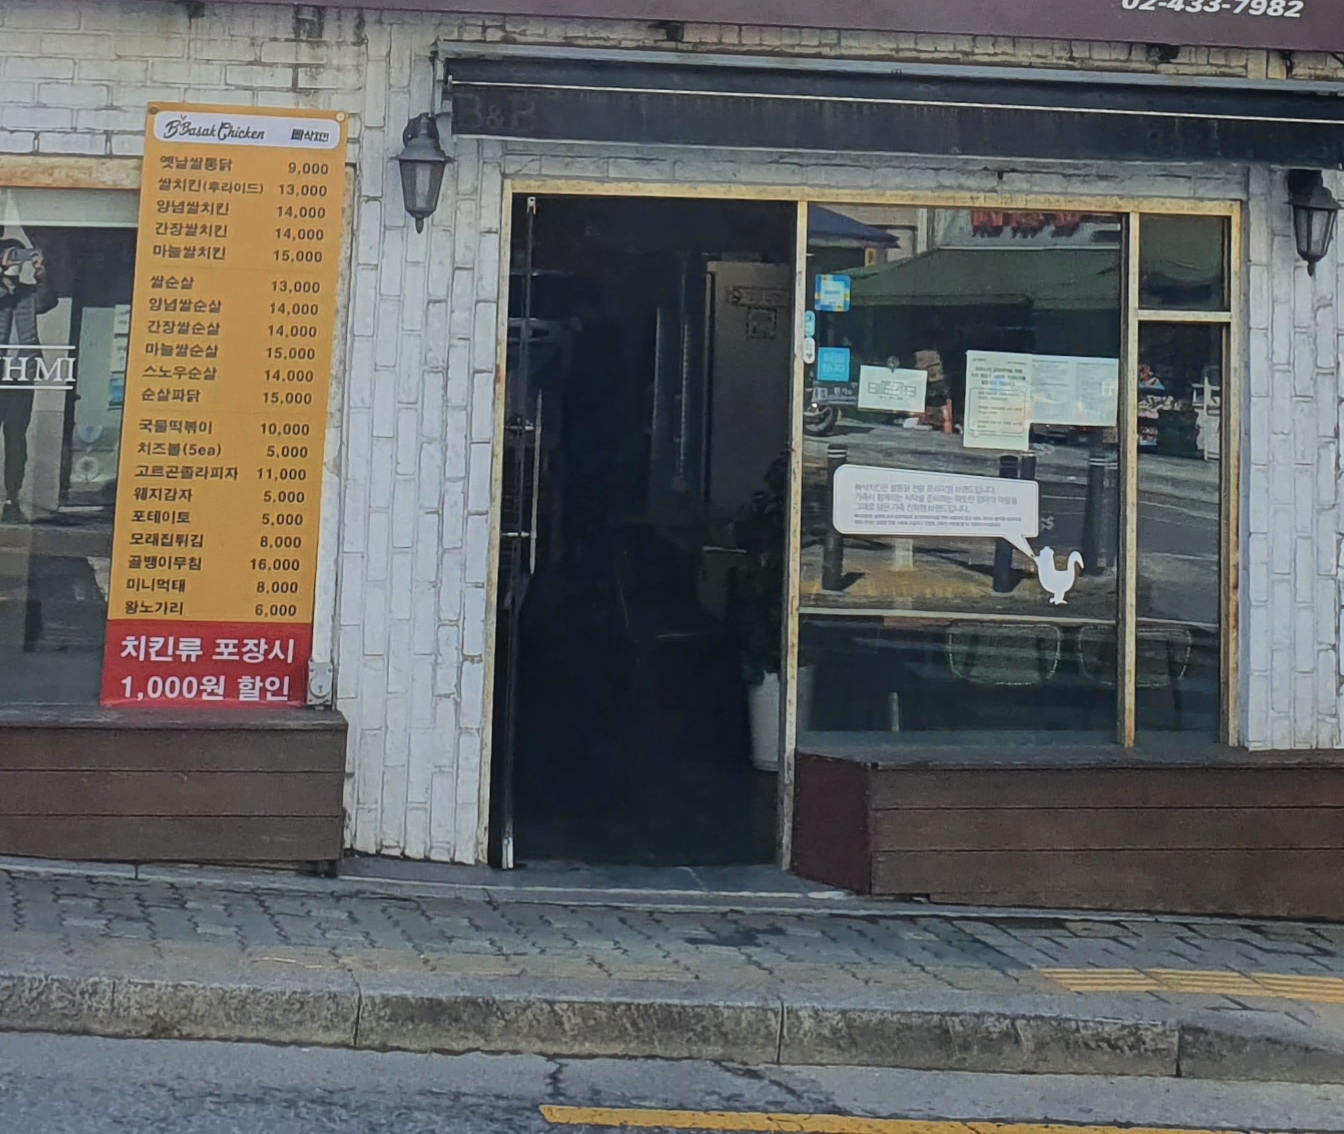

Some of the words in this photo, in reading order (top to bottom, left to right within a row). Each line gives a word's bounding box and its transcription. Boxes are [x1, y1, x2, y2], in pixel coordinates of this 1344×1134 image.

[218, 121, 266, 141] Chicken
[160, 155, 233, 172] 옛날쌀통닭
[288, 162, 329, 175] 9,000
[158, 177, 264, 195] 쌀치킨(후라이드)
[279, 183, 327, 197] 13,000
[156, 199, 230, 216] 양념쌀치킨
[277, 205, 326, 219] 14,000
[155, 222, 228, 238] 간장쌀치킨
[275, 227, 324, 241] 14,000
[153, 244, 226, 260] 마늘쌀치킨
[273, 250, 323, 263] 15,000
[150, 274, 195, 291] 쌀순살
[271, 280, 320, 294] 13,000
[149, 297, 222, 314] 양념쌀순살
[269, 302, 319, 316] 14,000
[147, 320, 221, 336] 간장쌀순살
[267, 324, 317, 338] 14,000
[145, 342, 219, 359] 마늘쌀순살
[266, 347, 315, 361] 15,000
[142, 365, 218, 381] 스노우순살
[264, 369, 314, 383] 14,000
[141, 387, 201, 404] 순살파닭
[263, 392, 312, 405] 15,000
[139, 419, 213, 435] 국물떡볶이
[260, 422, 310, 437] 10,000
[137, 441, 222, 457] 치즈볼(5ea)
[266, 445, 308, 459] 5,000
[134, 465, 239, 481] 고르곤졸라피자
[257, 468, 307, 482] 11,000
[134, 487, 193, 502] 웨지감자
[263, 490, 305, 504] 5,000
[131, 510, 191, 525] 포테이토
[261, 513, 303, 527] 5,000
[129, 532, 204, 549] 모래집튀김
[260, 536, 302, 549] 8,000
[128, 555, 202, 571] 골뱅이무침
[250, 558, 300, 572] 16,000
[126, 578, 186, 593] 미니먹태
[257, 581, 298, 595] 8,000
[124, 601, 184, 616] 왕노가리
[255, 604, 297, 618] 6,000
[120, 634, 204, 662] 치킨류
[212, 638, 295, 664] 포장시
[121, 675, 226, 701] 1,000원
[237, 676, 290, 702] 할인
